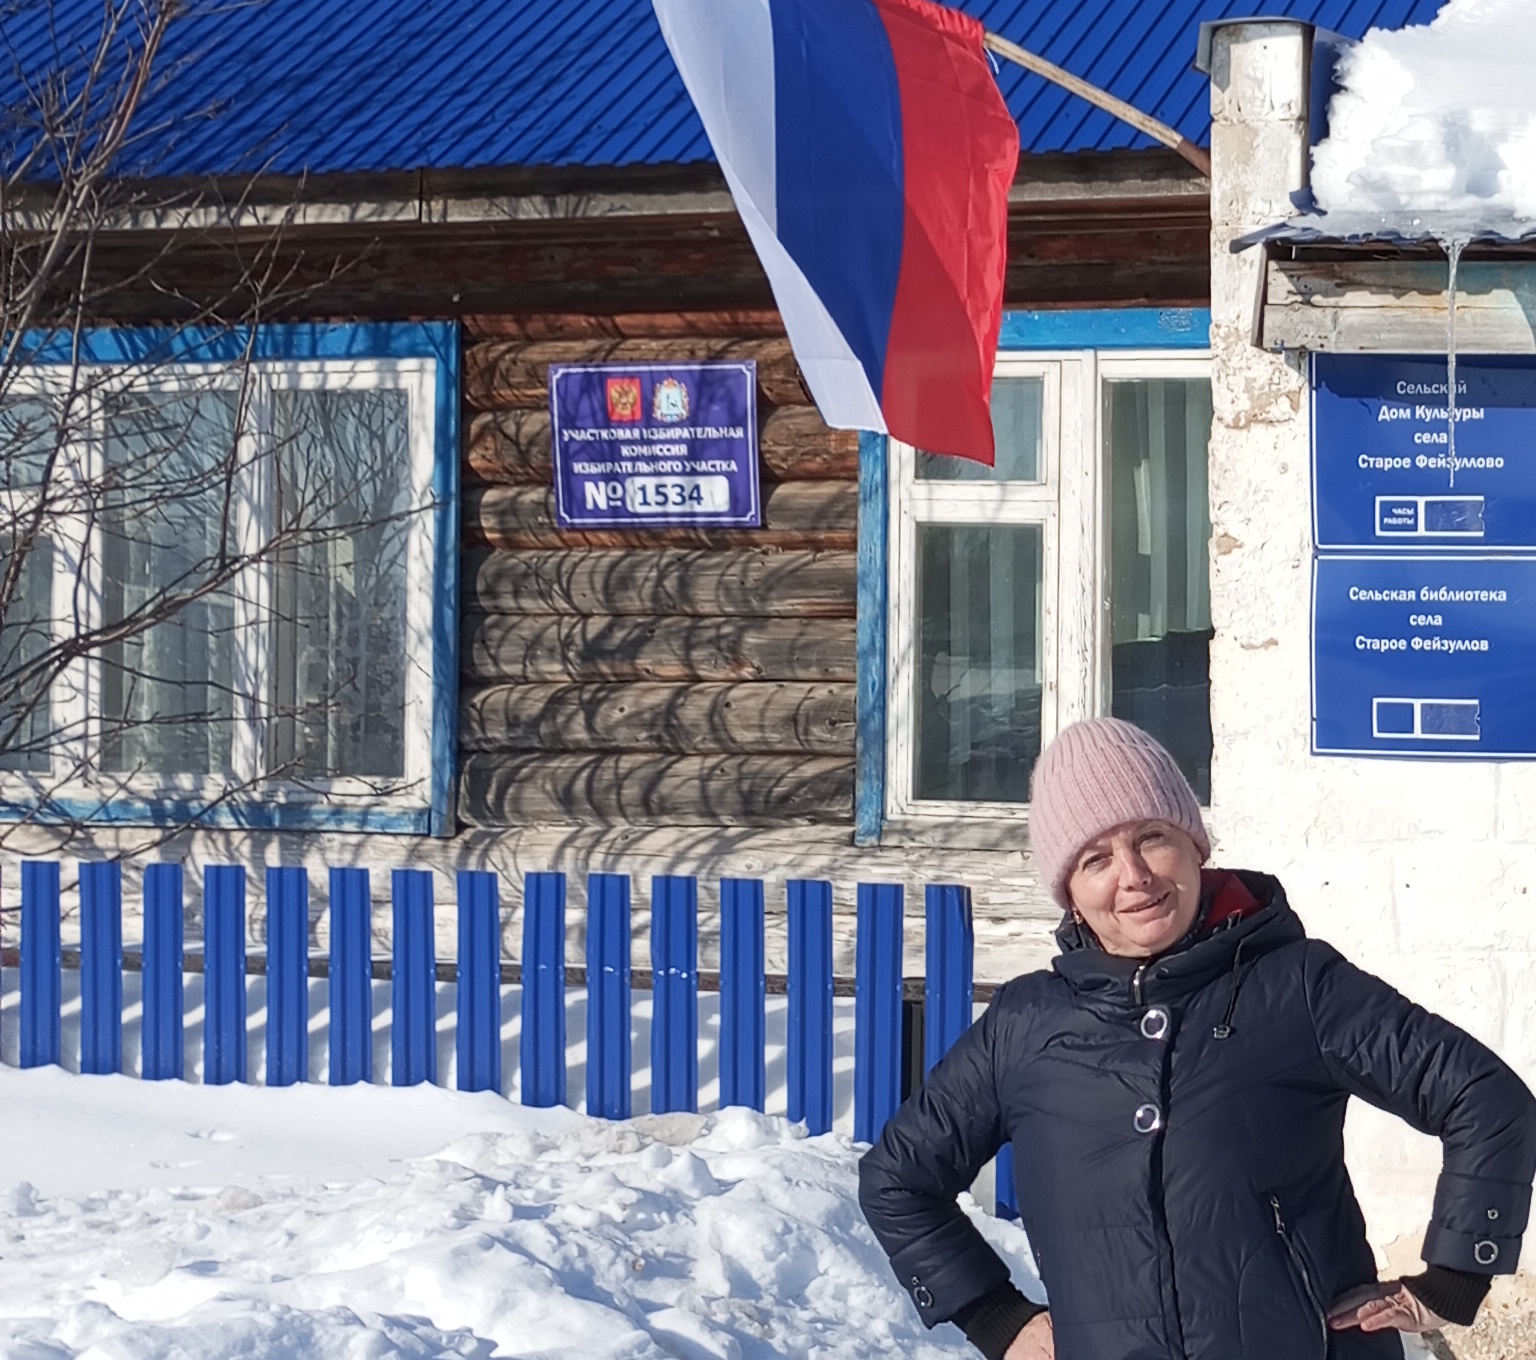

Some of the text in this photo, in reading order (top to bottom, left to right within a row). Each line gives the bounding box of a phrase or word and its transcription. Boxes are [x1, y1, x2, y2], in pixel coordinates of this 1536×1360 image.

[1396, 380, 1467, 395] Сельскй
[1378, 405, 1411, 422] Дом
[562, 427, 744, 441] УЧАСТКОВАЯ ИЗБИРАТЕЛЬНАЯ
[1413, 432, 1448, 444] села
[620, 444, 688, 457] КОМИССИЯ
[572, 459, 738, 474] ИЗБИРАТЕЛЬНОГО УЧАСТКА
[1358, 454, 1411, 471] Старое
[584, 481, 704, 510] № 1534
[1383, 517, 1415, 525] РАБОТЫ
[1349, 586, 1507, 602] Сельская библиотека
[1409, 614, 1443, 626] села
[1355, 636, 1489, 654] Старое Фейзуллов
